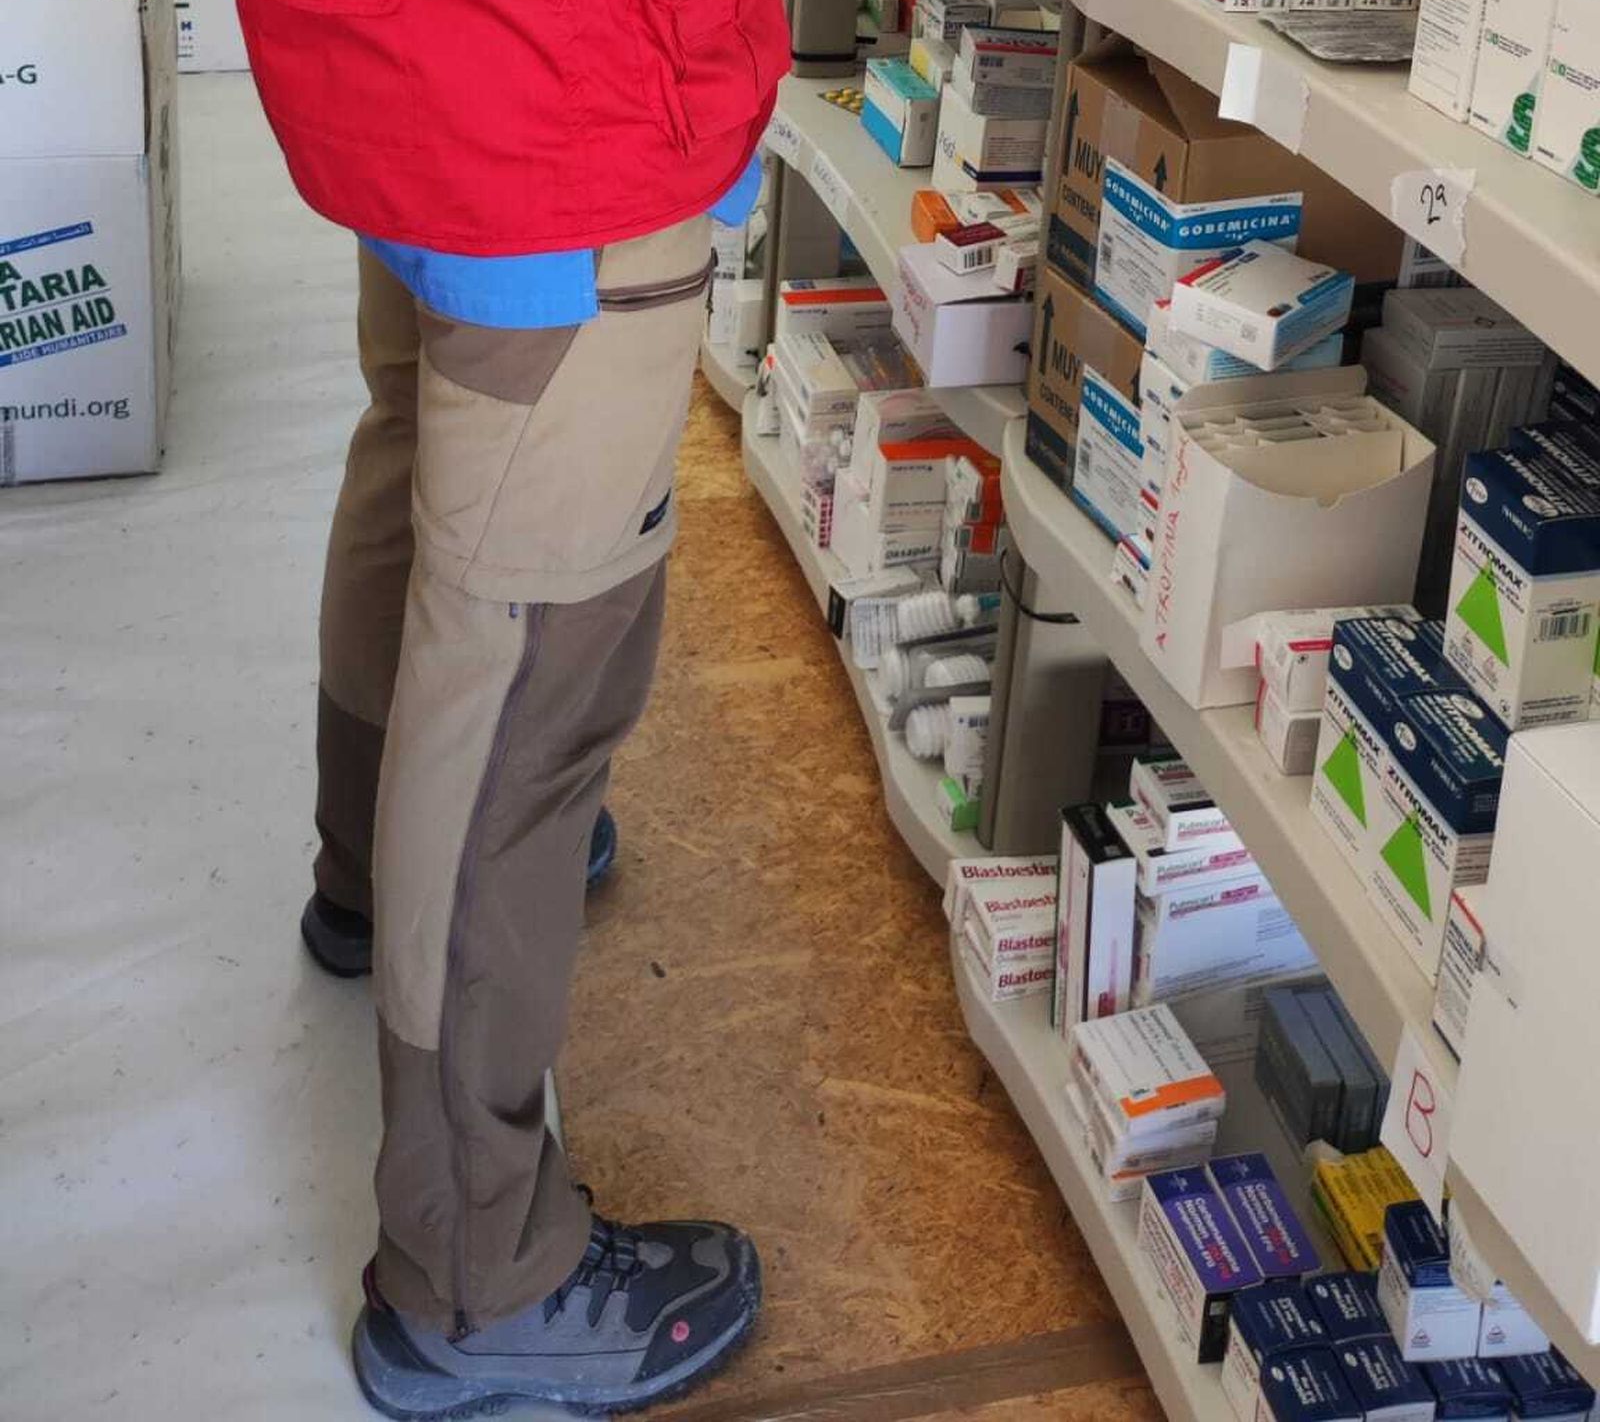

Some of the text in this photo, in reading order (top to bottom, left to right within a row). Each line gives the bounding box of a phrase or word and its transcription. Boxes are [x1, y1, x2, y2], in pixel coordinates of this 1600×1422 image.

[71, 296, 116, 333] AID
[1460, 522, 1524, 590] ZITROMAX
[1328, 688, 1381, 757] ZITROMAX
[1387, 767, 1449, 847] ZITROMAX
